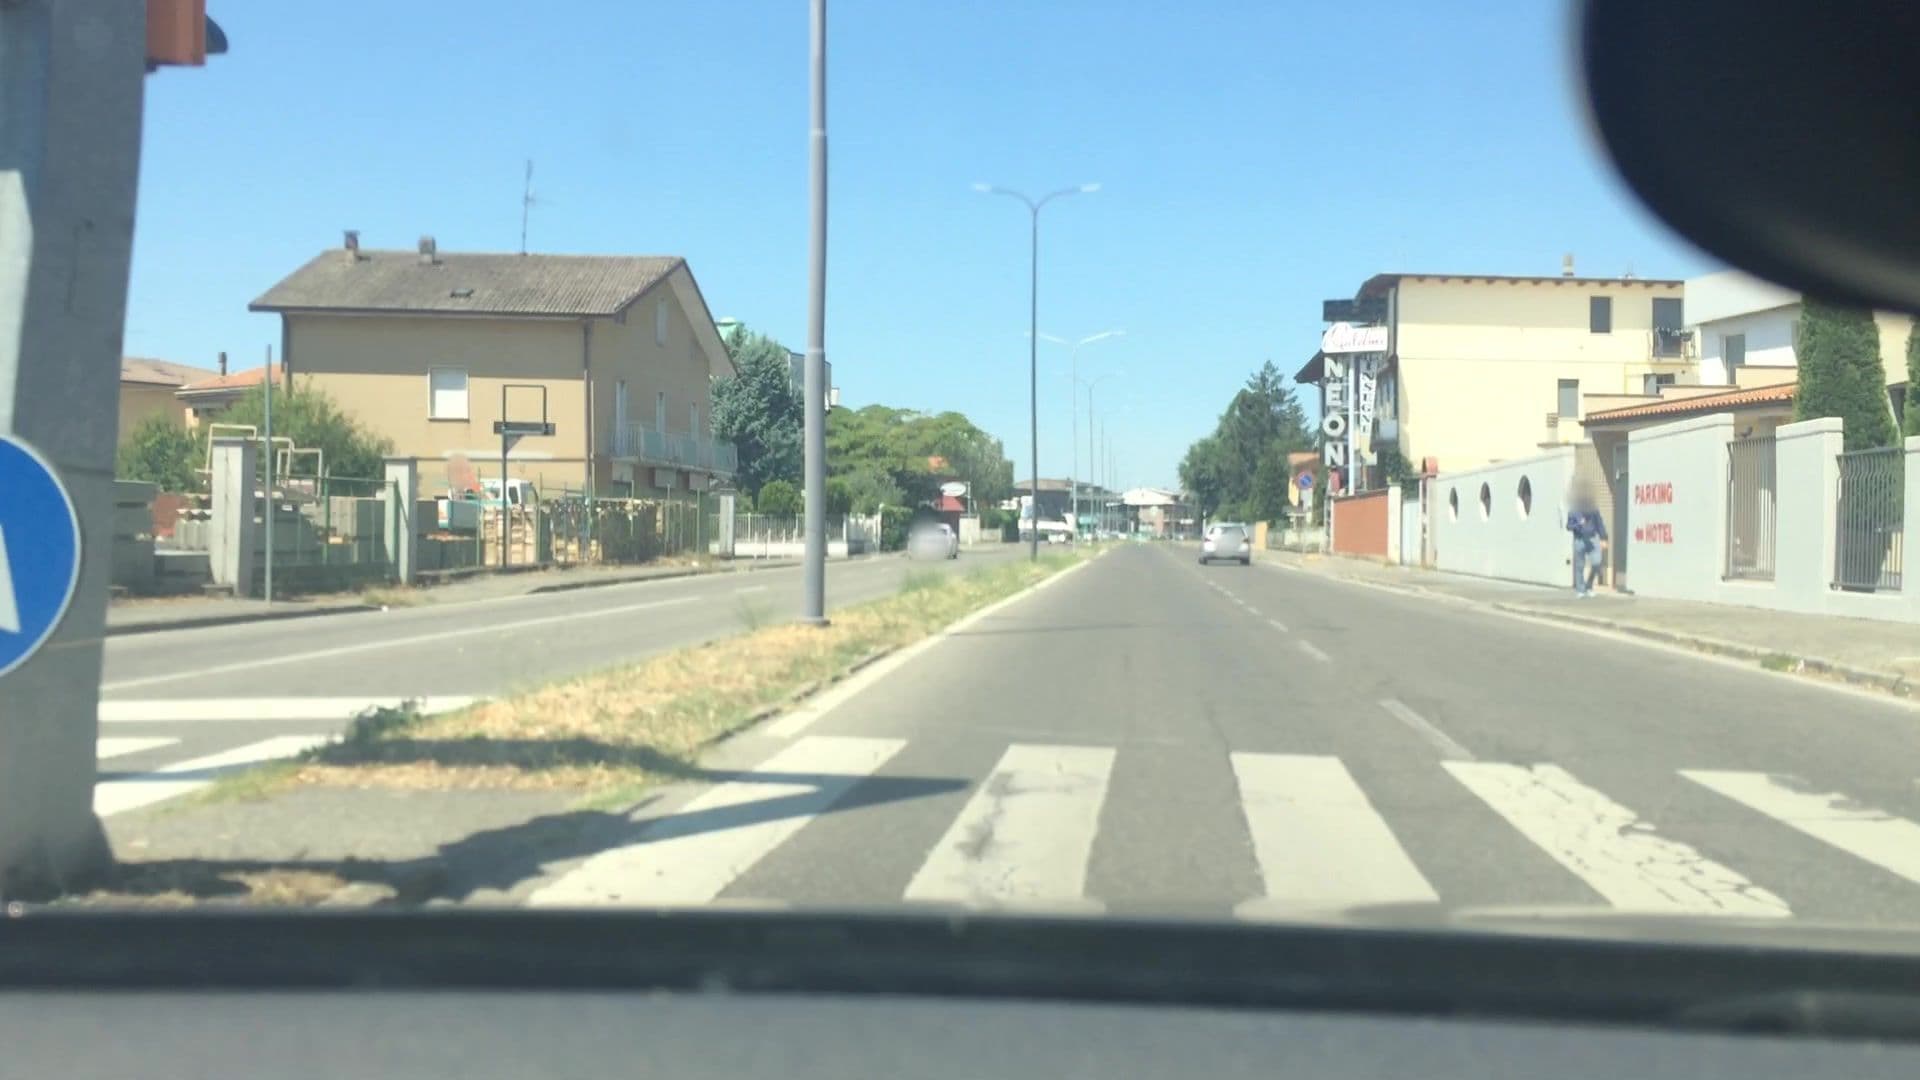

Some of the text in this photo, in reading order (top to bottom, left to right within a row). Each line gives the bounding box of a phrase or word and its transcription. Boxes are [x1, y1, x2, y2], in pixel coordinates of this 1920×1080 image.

[1323, 357, 1345, 466] NEON
[1635, 482, 1672, 504] PARKING
[1646, 523, 1673, 544] HOTEL
